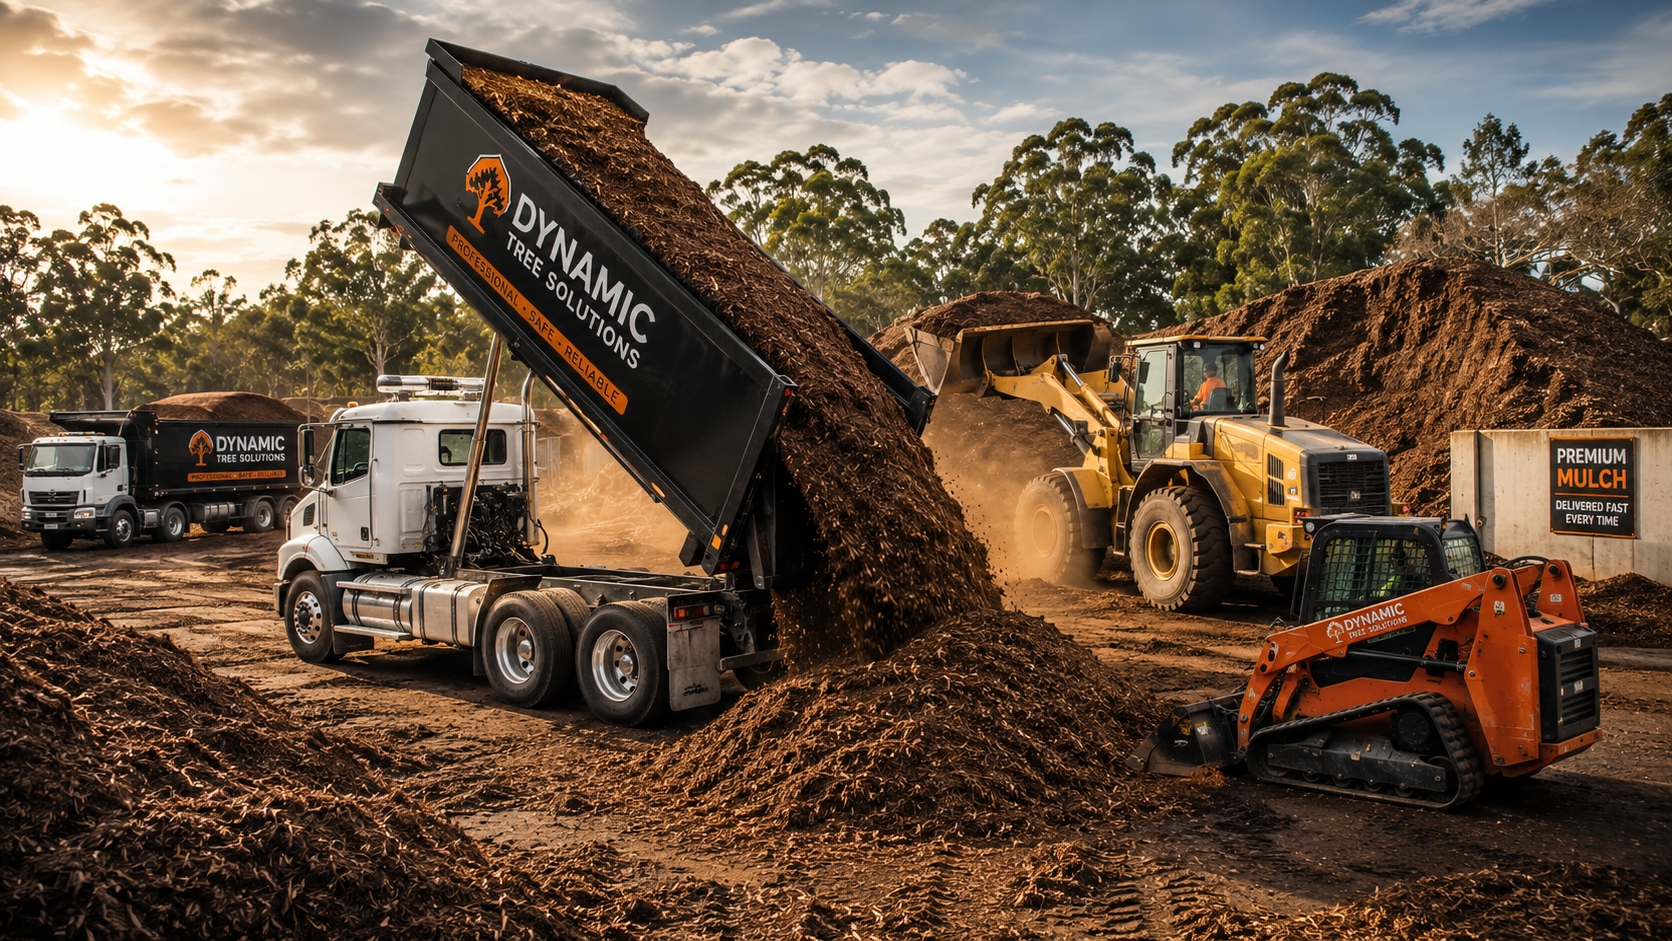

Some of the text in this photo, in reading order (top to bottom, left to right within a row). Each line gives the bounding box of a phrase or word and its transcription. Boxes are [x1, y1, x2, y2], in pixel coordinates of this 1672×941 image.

[512, 193, 655, 343] DYNAMIC
[507, 231, 641, 369] TREE SOLUTIONS
[451, 234, 619, 404] PROFESSIONAL SAFE RELIABLE
[216, 436, 285, 452] DYNAMIC
[217, 453, 286, 463] TREE SOLUTIONS
[1557, 448, 1626, 464] PREMIUM
[1557, 468, 1627, 489] MULCH
[1555, 500, 1629, 513] DELIVERED FAST
[1565, 514, 1619, 526] EVERY TIME
[1343, 603, 1404, 631] DYNAMIC
